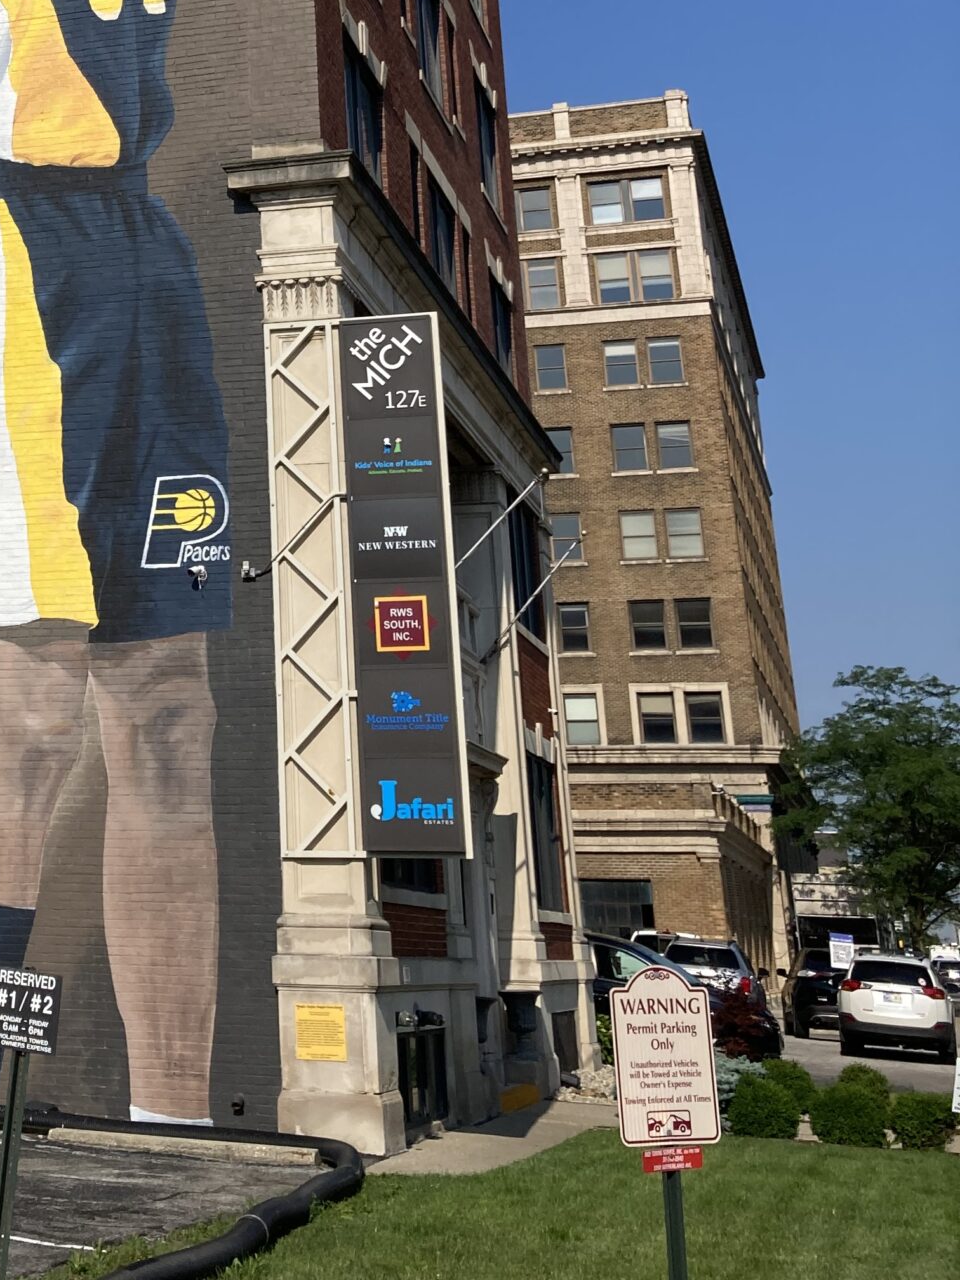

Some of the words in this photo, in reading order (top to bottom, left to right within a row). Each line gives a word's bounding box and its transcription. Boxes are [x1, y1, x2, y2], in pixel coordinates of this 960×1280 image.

[349, 327, 386, 361] the
[352, 324, 423, 400] MICH
[373, 460, 394, 469] Voice
[395, 459, 404, 467] of
[405, 458, 433, 467] Indiana
[358, 541, 382, 551] NEW
[385, 539, 436, 550] WESTERN
[183, 544, 231, 562] Pacers
[390, 607, 413, 617] RWS
[384, 619, 421, 629] SOUTH,
[392, 631, 413, 641] INC.
[367, 713, 423, 724] Monument
[425, 713, 449, 723] Title
[370, 780, 454, 821] Jafari
[0, 969, 56, 989] RESERVED
[620, 997, 701, 1015] WARNING
[2, 1021, 19, 1032] 6AM
[28, 1025, 44, 1037] 6PM
[29, 1019, 49, 1028] FRIDAY
[626, 1022, 658, 1035] Permit
[660, 1021, 697, 1037] Parking
[0, 1039, 26, 1049] OWNERS
[26, 1044, 52, 1054] EXPENSE
[29, 1038, 49, 1046] TOWED
[650, 1037, 675, 1054] Only
[630, 1060, 672, 1069] Unauthorized
[673, 1059, 699, 1068] Vehicles
[629, 1071, 640, 1079] will
[642, 1070, 650, 1079] be
[650, 1070, 671, 1078] Towed
[679, 1069, 702, 1077] Vehicle
[667, 1080, 693, 1089] Expense
[625, 1096, 646, 1106] Towing
[647, 1094, 675, 1104] Enforced
[682, 1094, 693, 1102] All
[693, 1094, 712, 1102] Times
